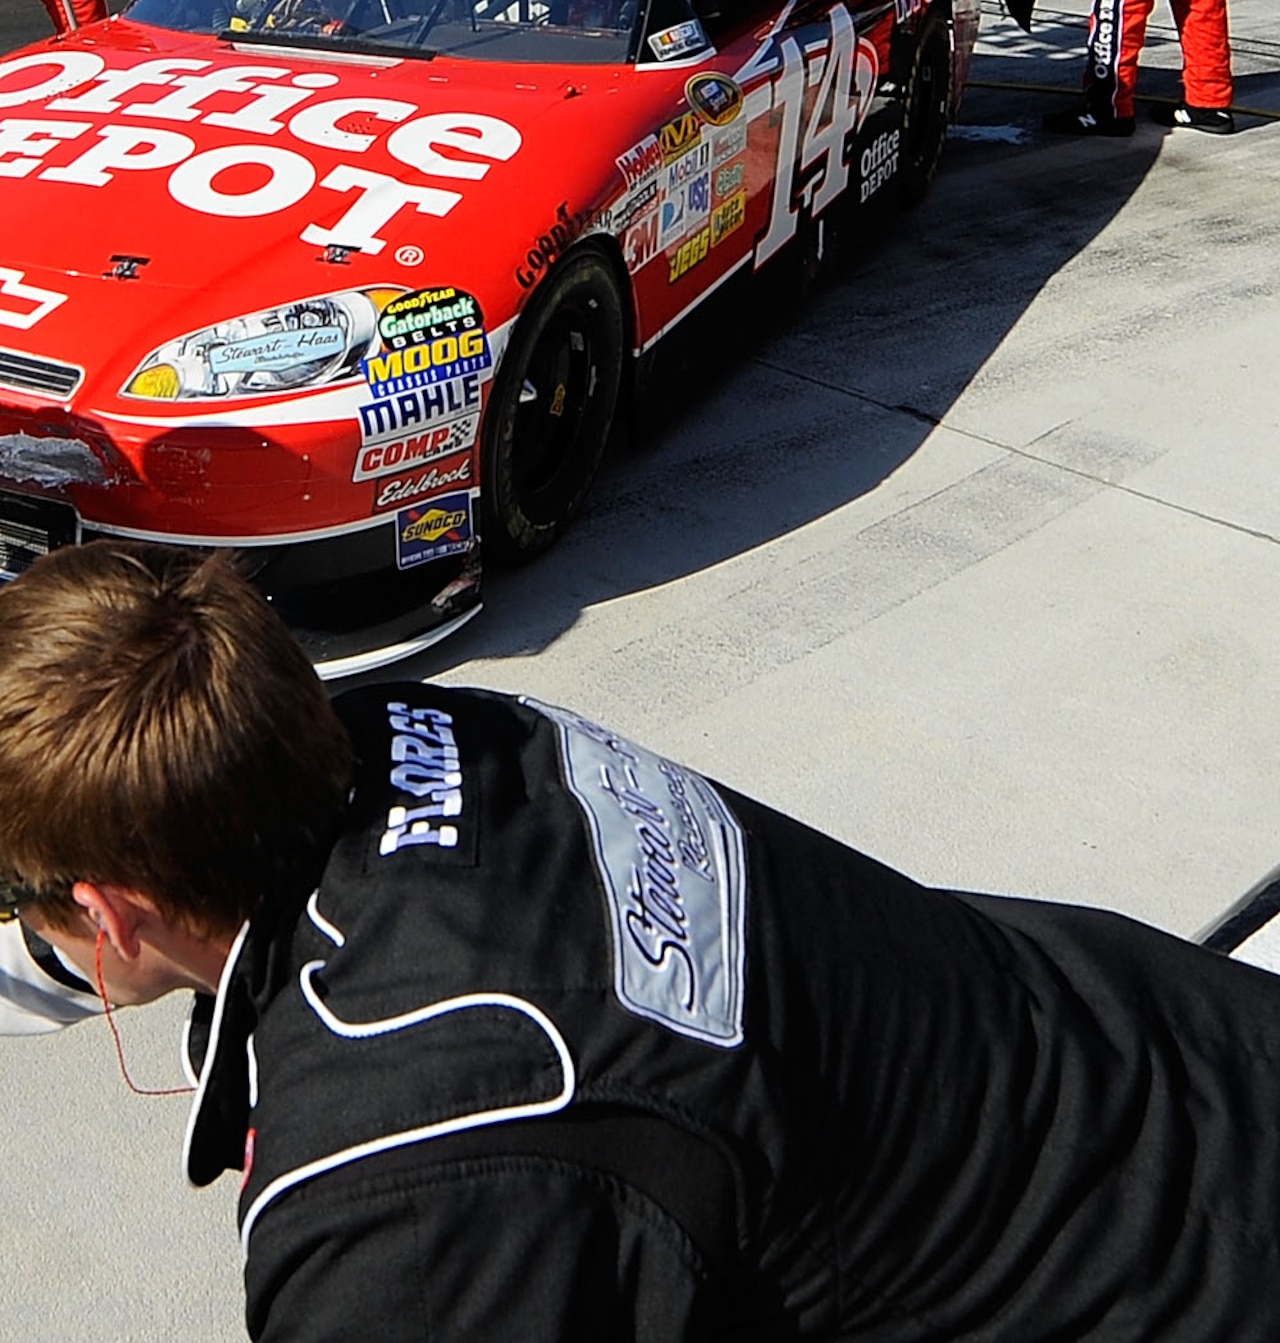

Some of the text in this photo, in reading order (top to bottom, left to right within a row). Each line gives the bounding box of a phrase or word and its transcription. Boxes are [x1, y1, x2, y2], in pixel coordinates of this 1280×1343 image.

[1095, 25, 1114, 80] Office
[754, 2, 860, 271] 14
[860, 128, 900, 177] Office
[670, 150, 698, 186] Mobil
[860, 153, 898, 203] DEPOT
[670, 227, 710, 282] JEGS
[379, 296, 476, 339] Gatorback
[387, 287, 456, 315] GOODYEAR
[367, 328, 484, 385] MOOG
[391, 316, 477, 349] BELTS
[377, 355, 487, 397] CHASSIS PARTS
[359, 375, 480, 436] MAHLE
[361, 427, 451, 473] COMP
[377, 458, 471, 506] Edelbrock
[405, 512, 464, 540] SUNOCO
[379, 702, 463, 856] FLORES
